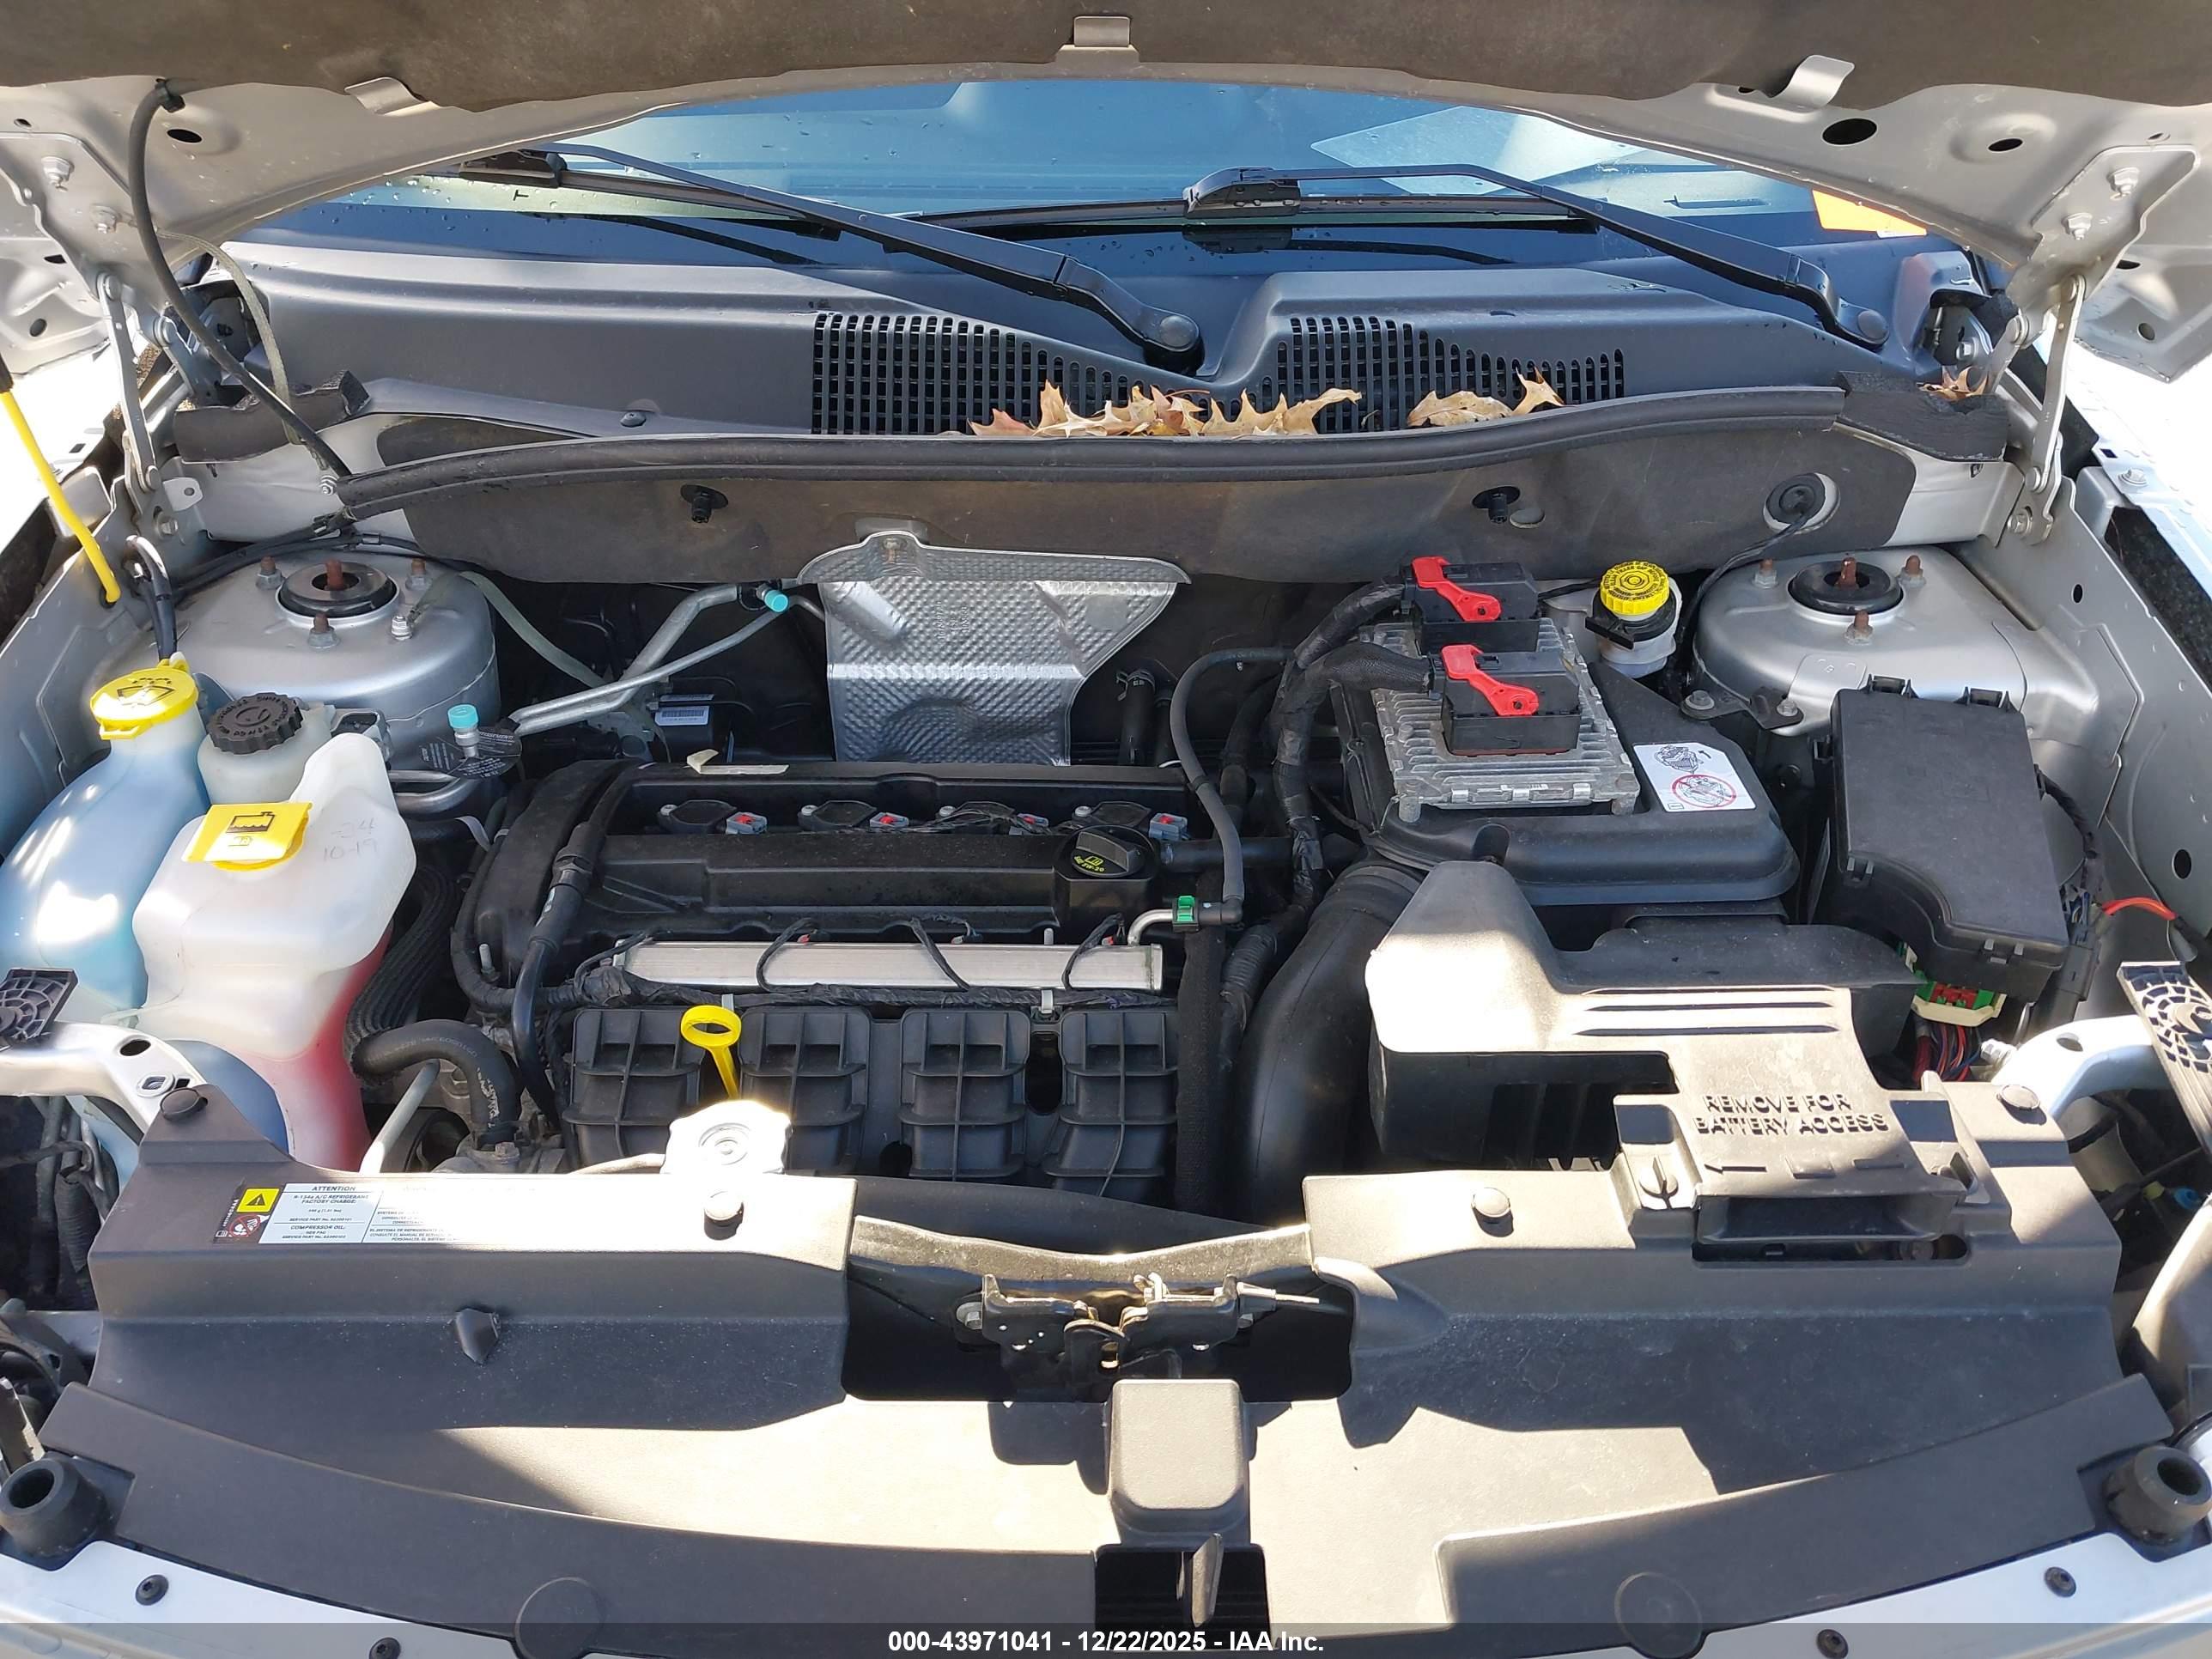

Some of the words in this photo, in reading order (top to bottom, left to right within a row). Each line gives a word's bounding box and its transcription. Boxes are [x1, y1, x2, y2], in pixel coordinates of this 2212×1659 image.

[1702, 1095, 1801, 1114] REMOVE
[1802, 1093, 1852, 1113] FOR
[1692, 1116, 1789, 1135] BATTERY
[1799, 1113, 1889, 1134] ACCESS
